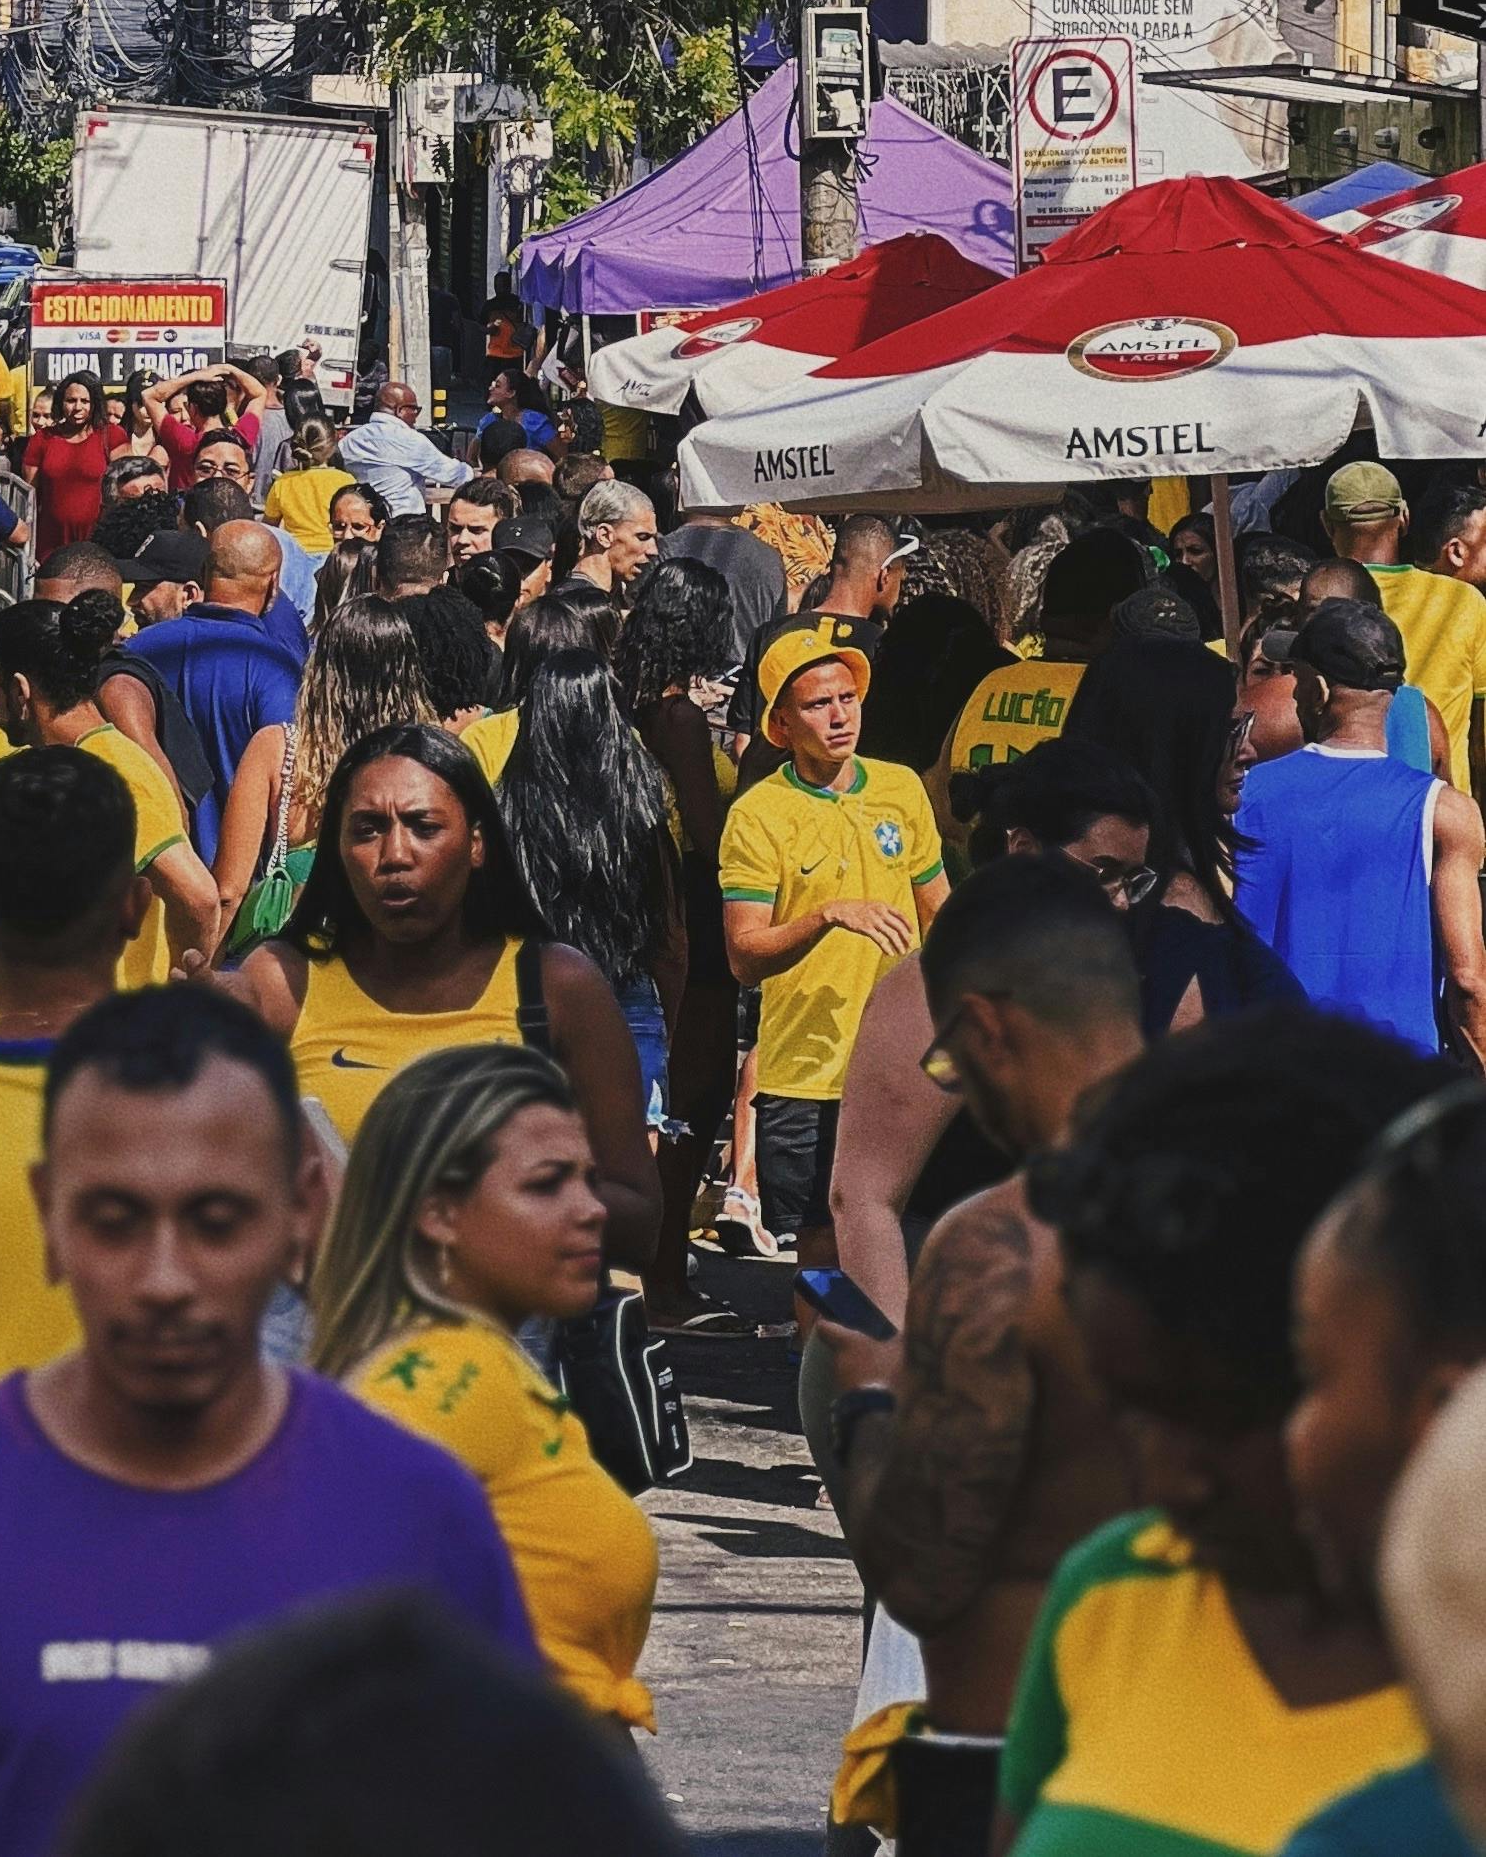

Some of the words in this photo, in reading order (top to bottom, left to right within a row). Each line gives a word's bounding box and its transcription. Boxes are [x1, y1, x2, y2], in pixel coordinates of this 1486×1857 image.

[1143, 22, 1179, 39] PARA
[1184, 22, 1194, 40] A
[1052, 66, 1095, 123] E
[43, 295, 213, 323] ESTACIONAMENTO
[78, 331, 101, 341] VISA
[1099, 338, 1207, 352] AMSTEL
[112, 352, 124, 382] E
[1119, 352, 1180, 363] LAGER
[1065, 422, 1216, 460] AMSTEL
[753, 443, 836, 484] AMSTEL
[981, 687, 1067, 728] LUCÃO
